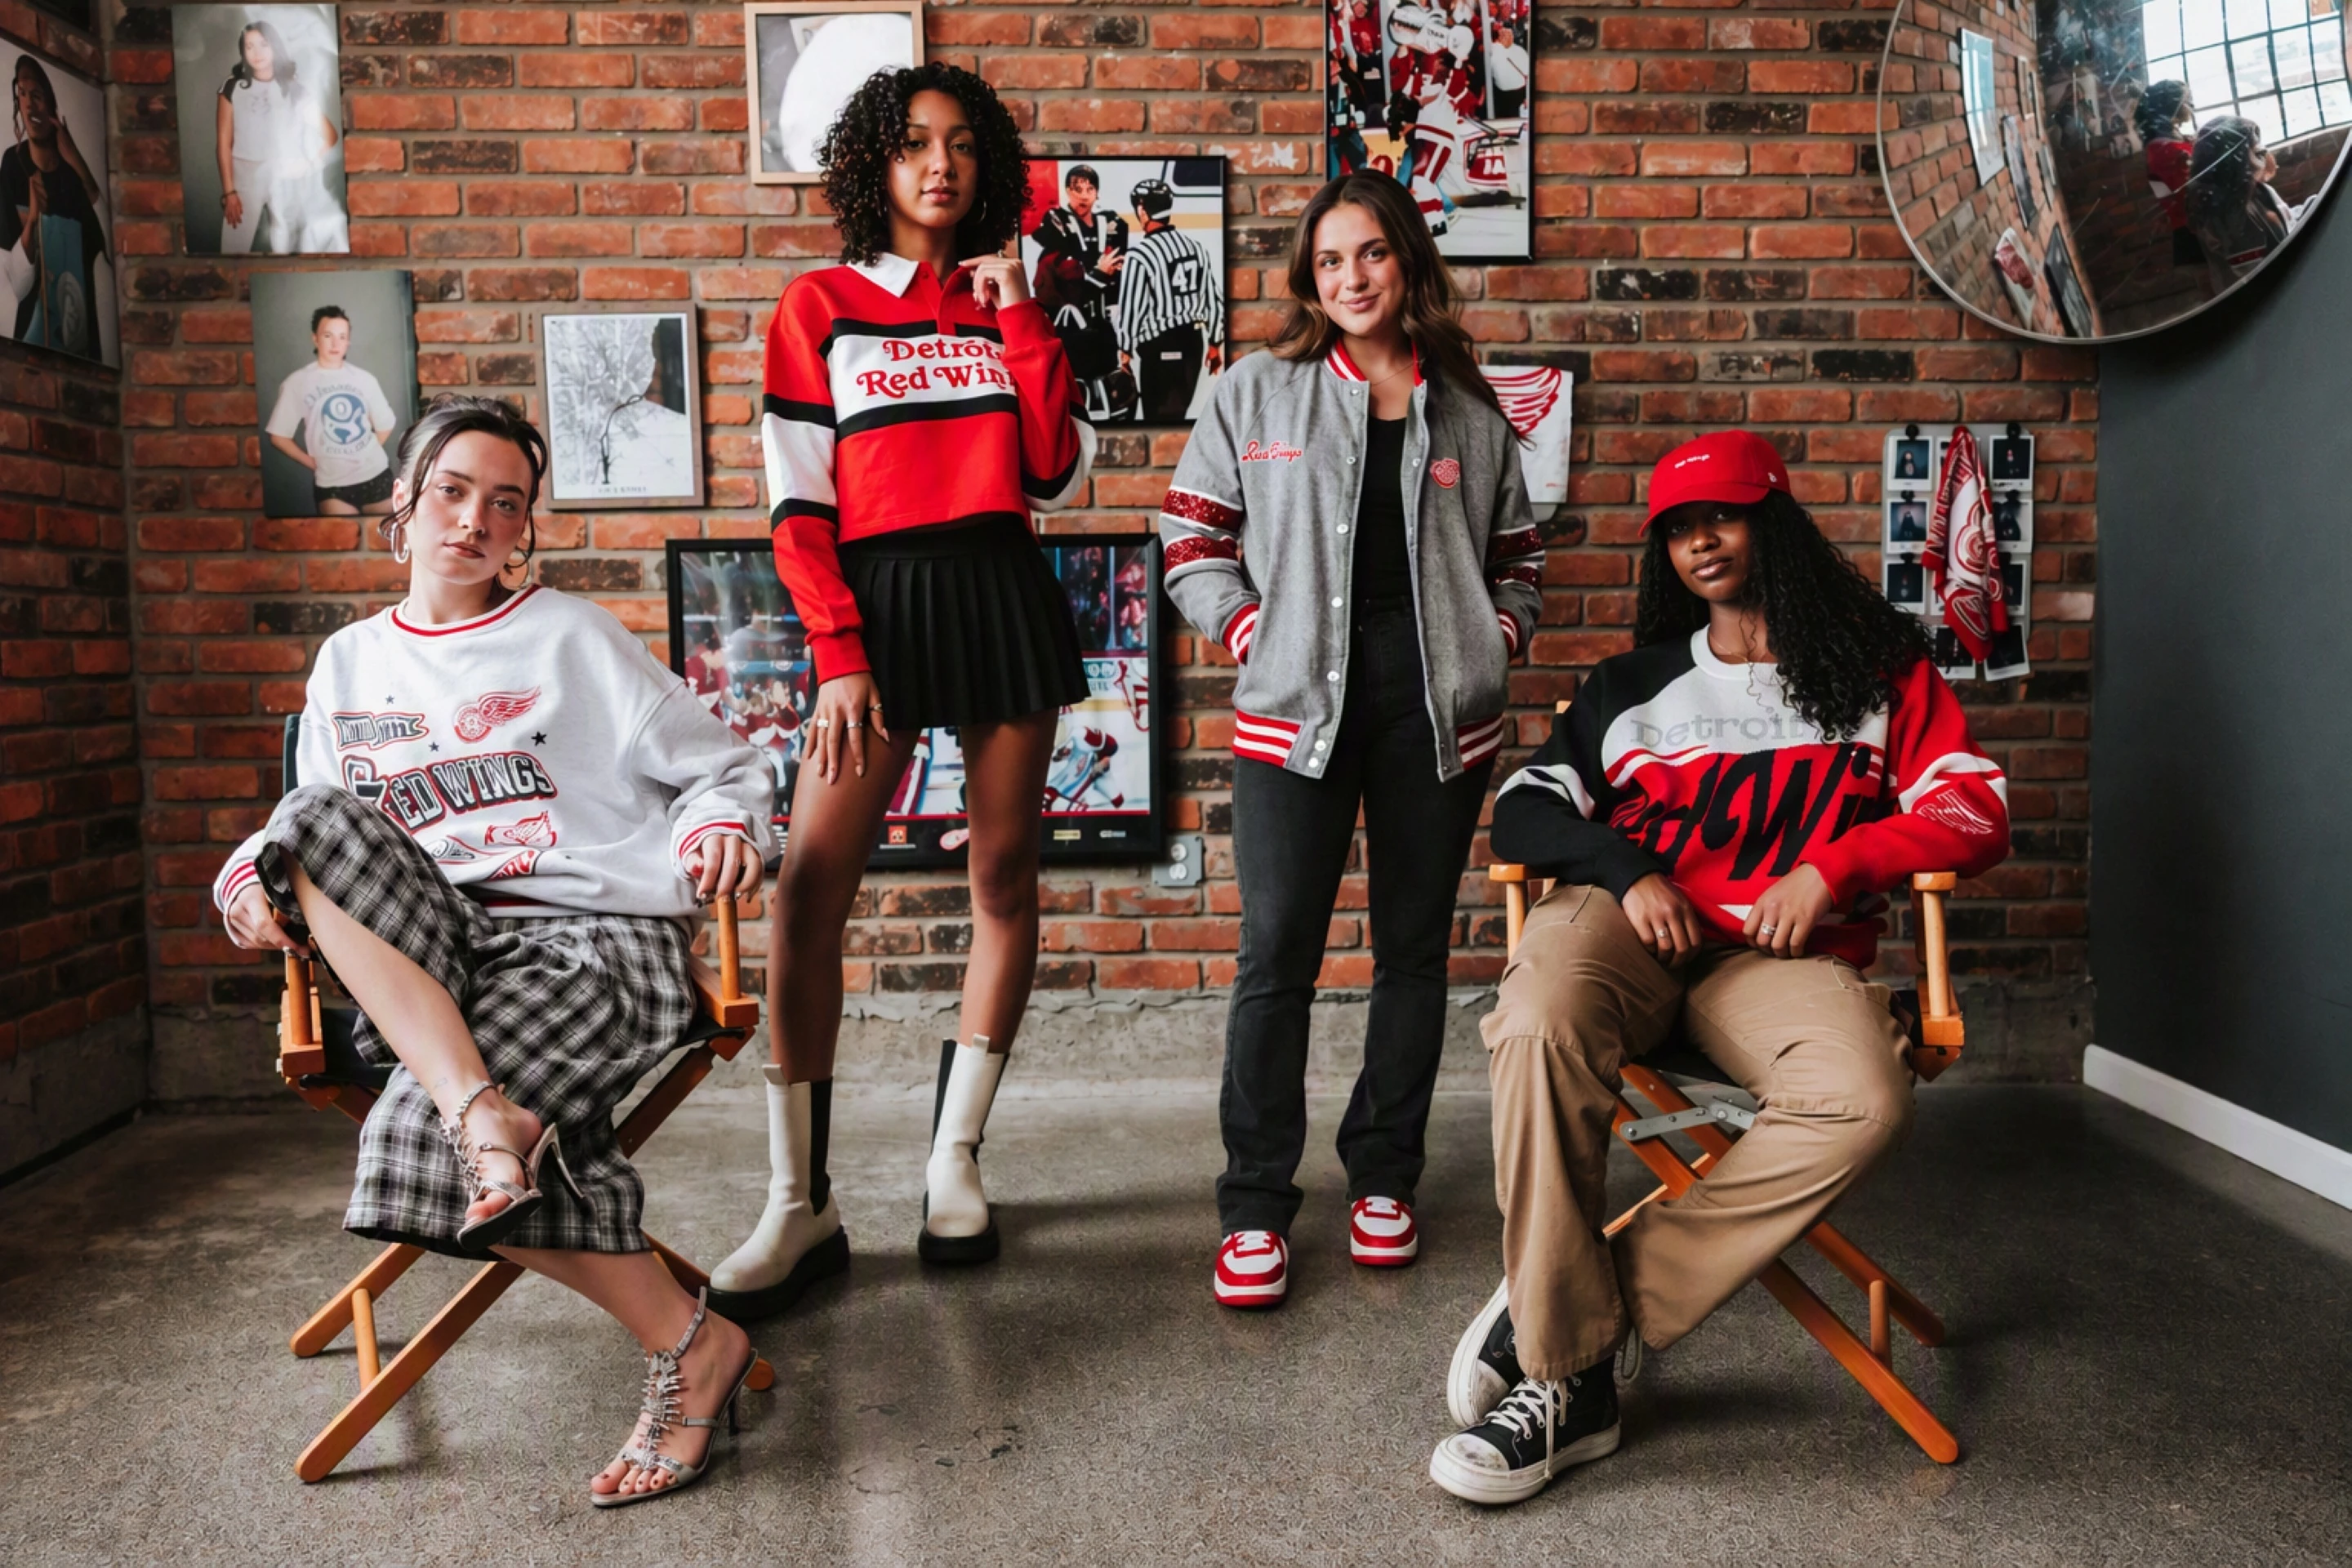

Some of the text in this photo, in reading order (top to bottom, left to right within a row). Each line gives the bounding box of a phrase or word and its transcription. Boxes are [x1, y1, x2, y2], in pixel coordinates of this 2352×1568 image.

[1172, 260, 1198, 292] 47
[856, 366, 930, 399] Red
[1630, 706, 1805, 747] Detroit
[430, 753, 557, 811] WINGS
